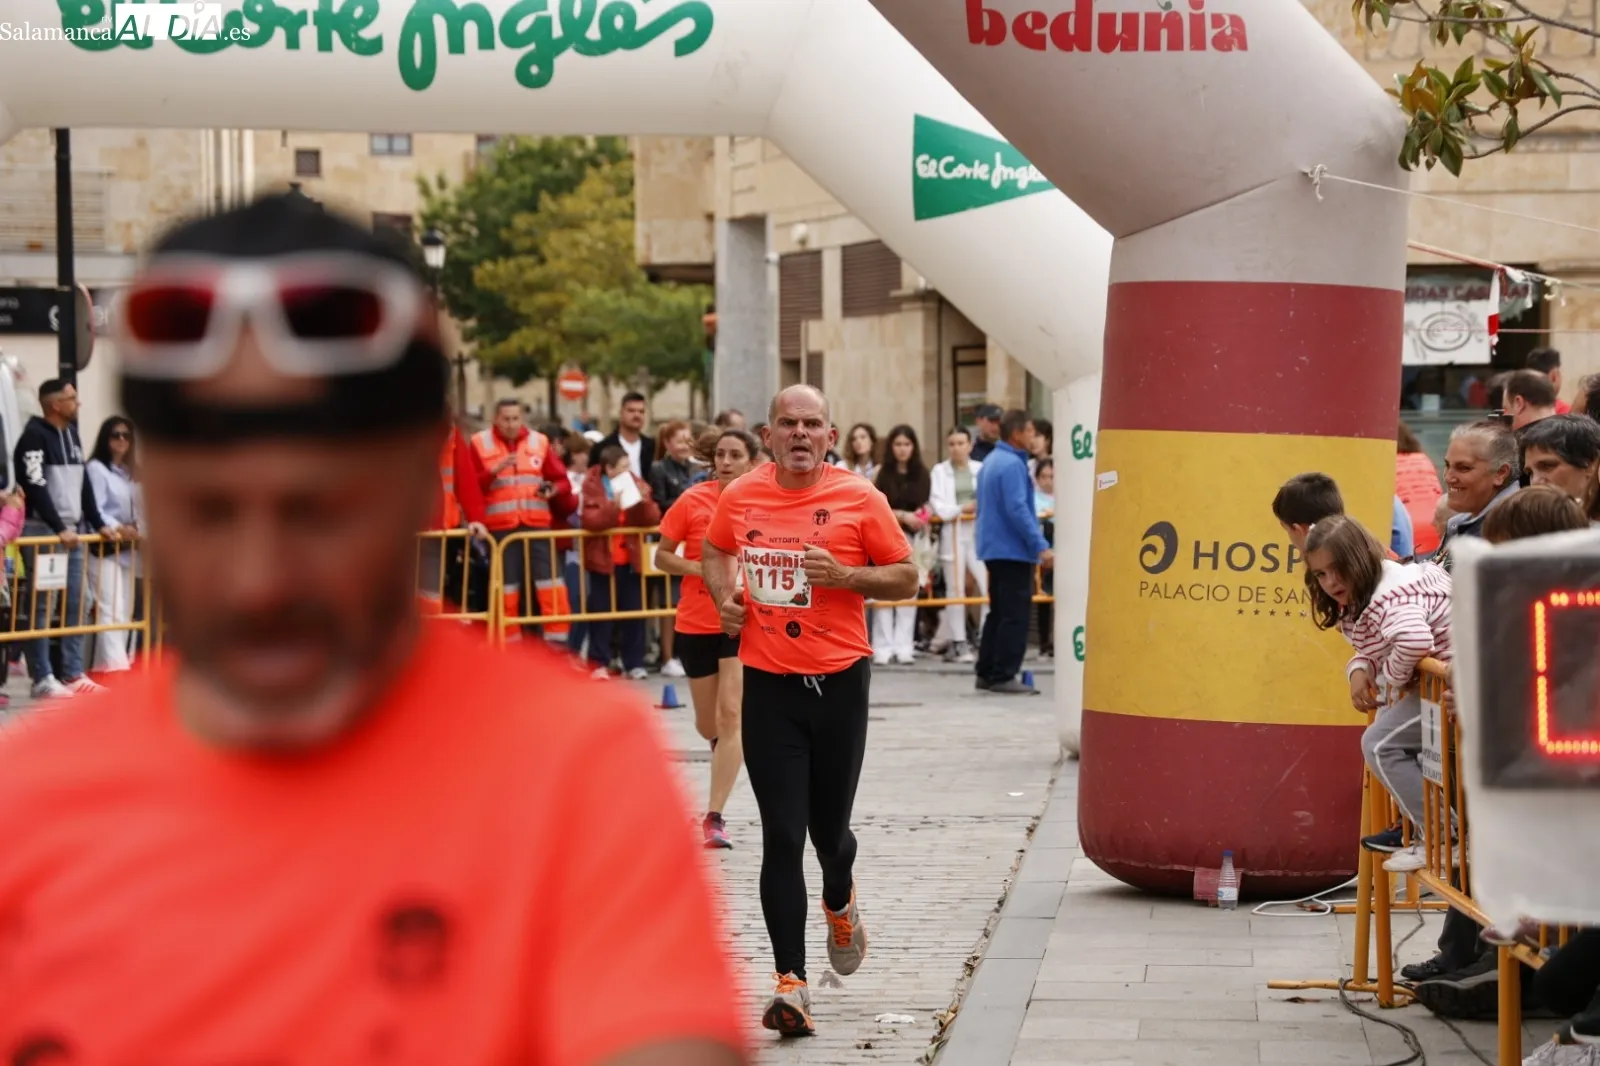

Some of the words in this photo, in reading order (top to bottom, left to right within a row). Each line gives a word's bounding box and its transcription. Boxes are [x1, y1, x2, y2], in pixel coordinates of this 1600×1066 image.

[965, 0, 1249, 54] bedunia
[915, 153, 938, 179] El
[938, 155, 990, 181] Corte
[990, 151, 1048, 190] Ingl
[1071, 424, 1093, 460] El
[1193, 540, 1303, 574] HOSP
[755, 568, 795, 591] 115
[1139, 580, 1230, 602] PALACIO
[1238, 585, 1266, 603] DE
[1072, 625, 1085, 662] E
